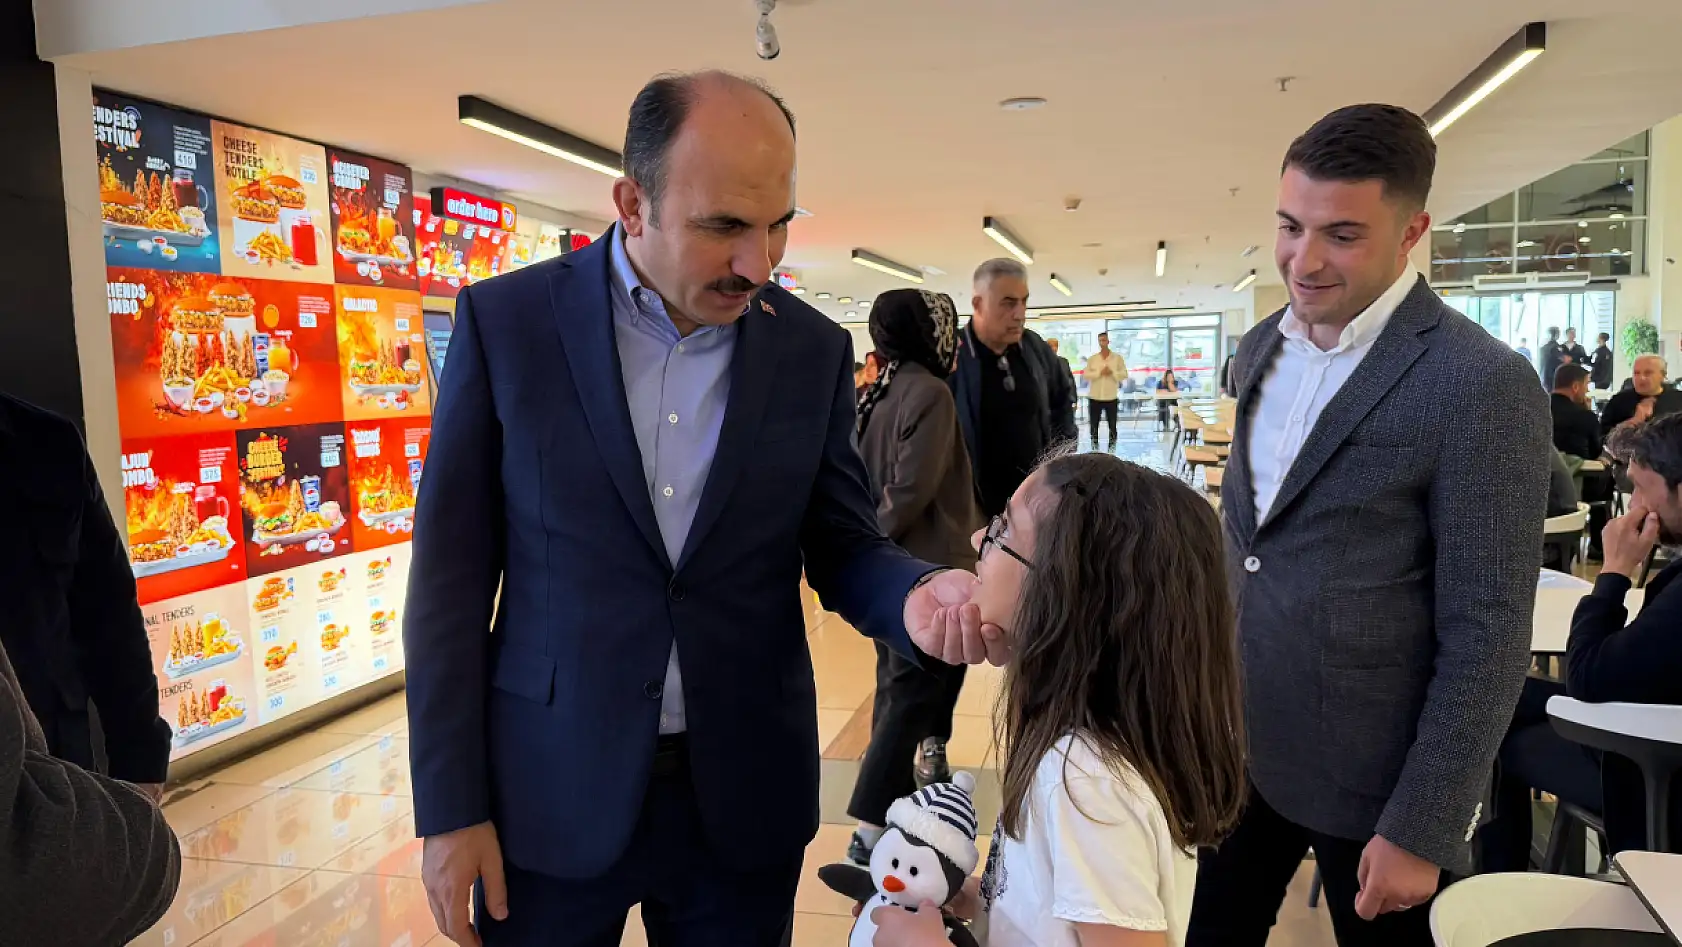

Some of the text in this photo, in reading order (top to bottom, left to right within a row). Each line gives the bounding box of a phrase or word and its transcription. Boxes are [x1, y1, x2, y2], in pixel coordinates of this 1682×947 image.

[223, 135, 257, 154] CHEESE
[224, 150, 264, 168] TENDERS
[447, 198, 476, 217] order
[161, 605, 195, 622] TENDERS
[160, 679, 193, 699] TENDERS
